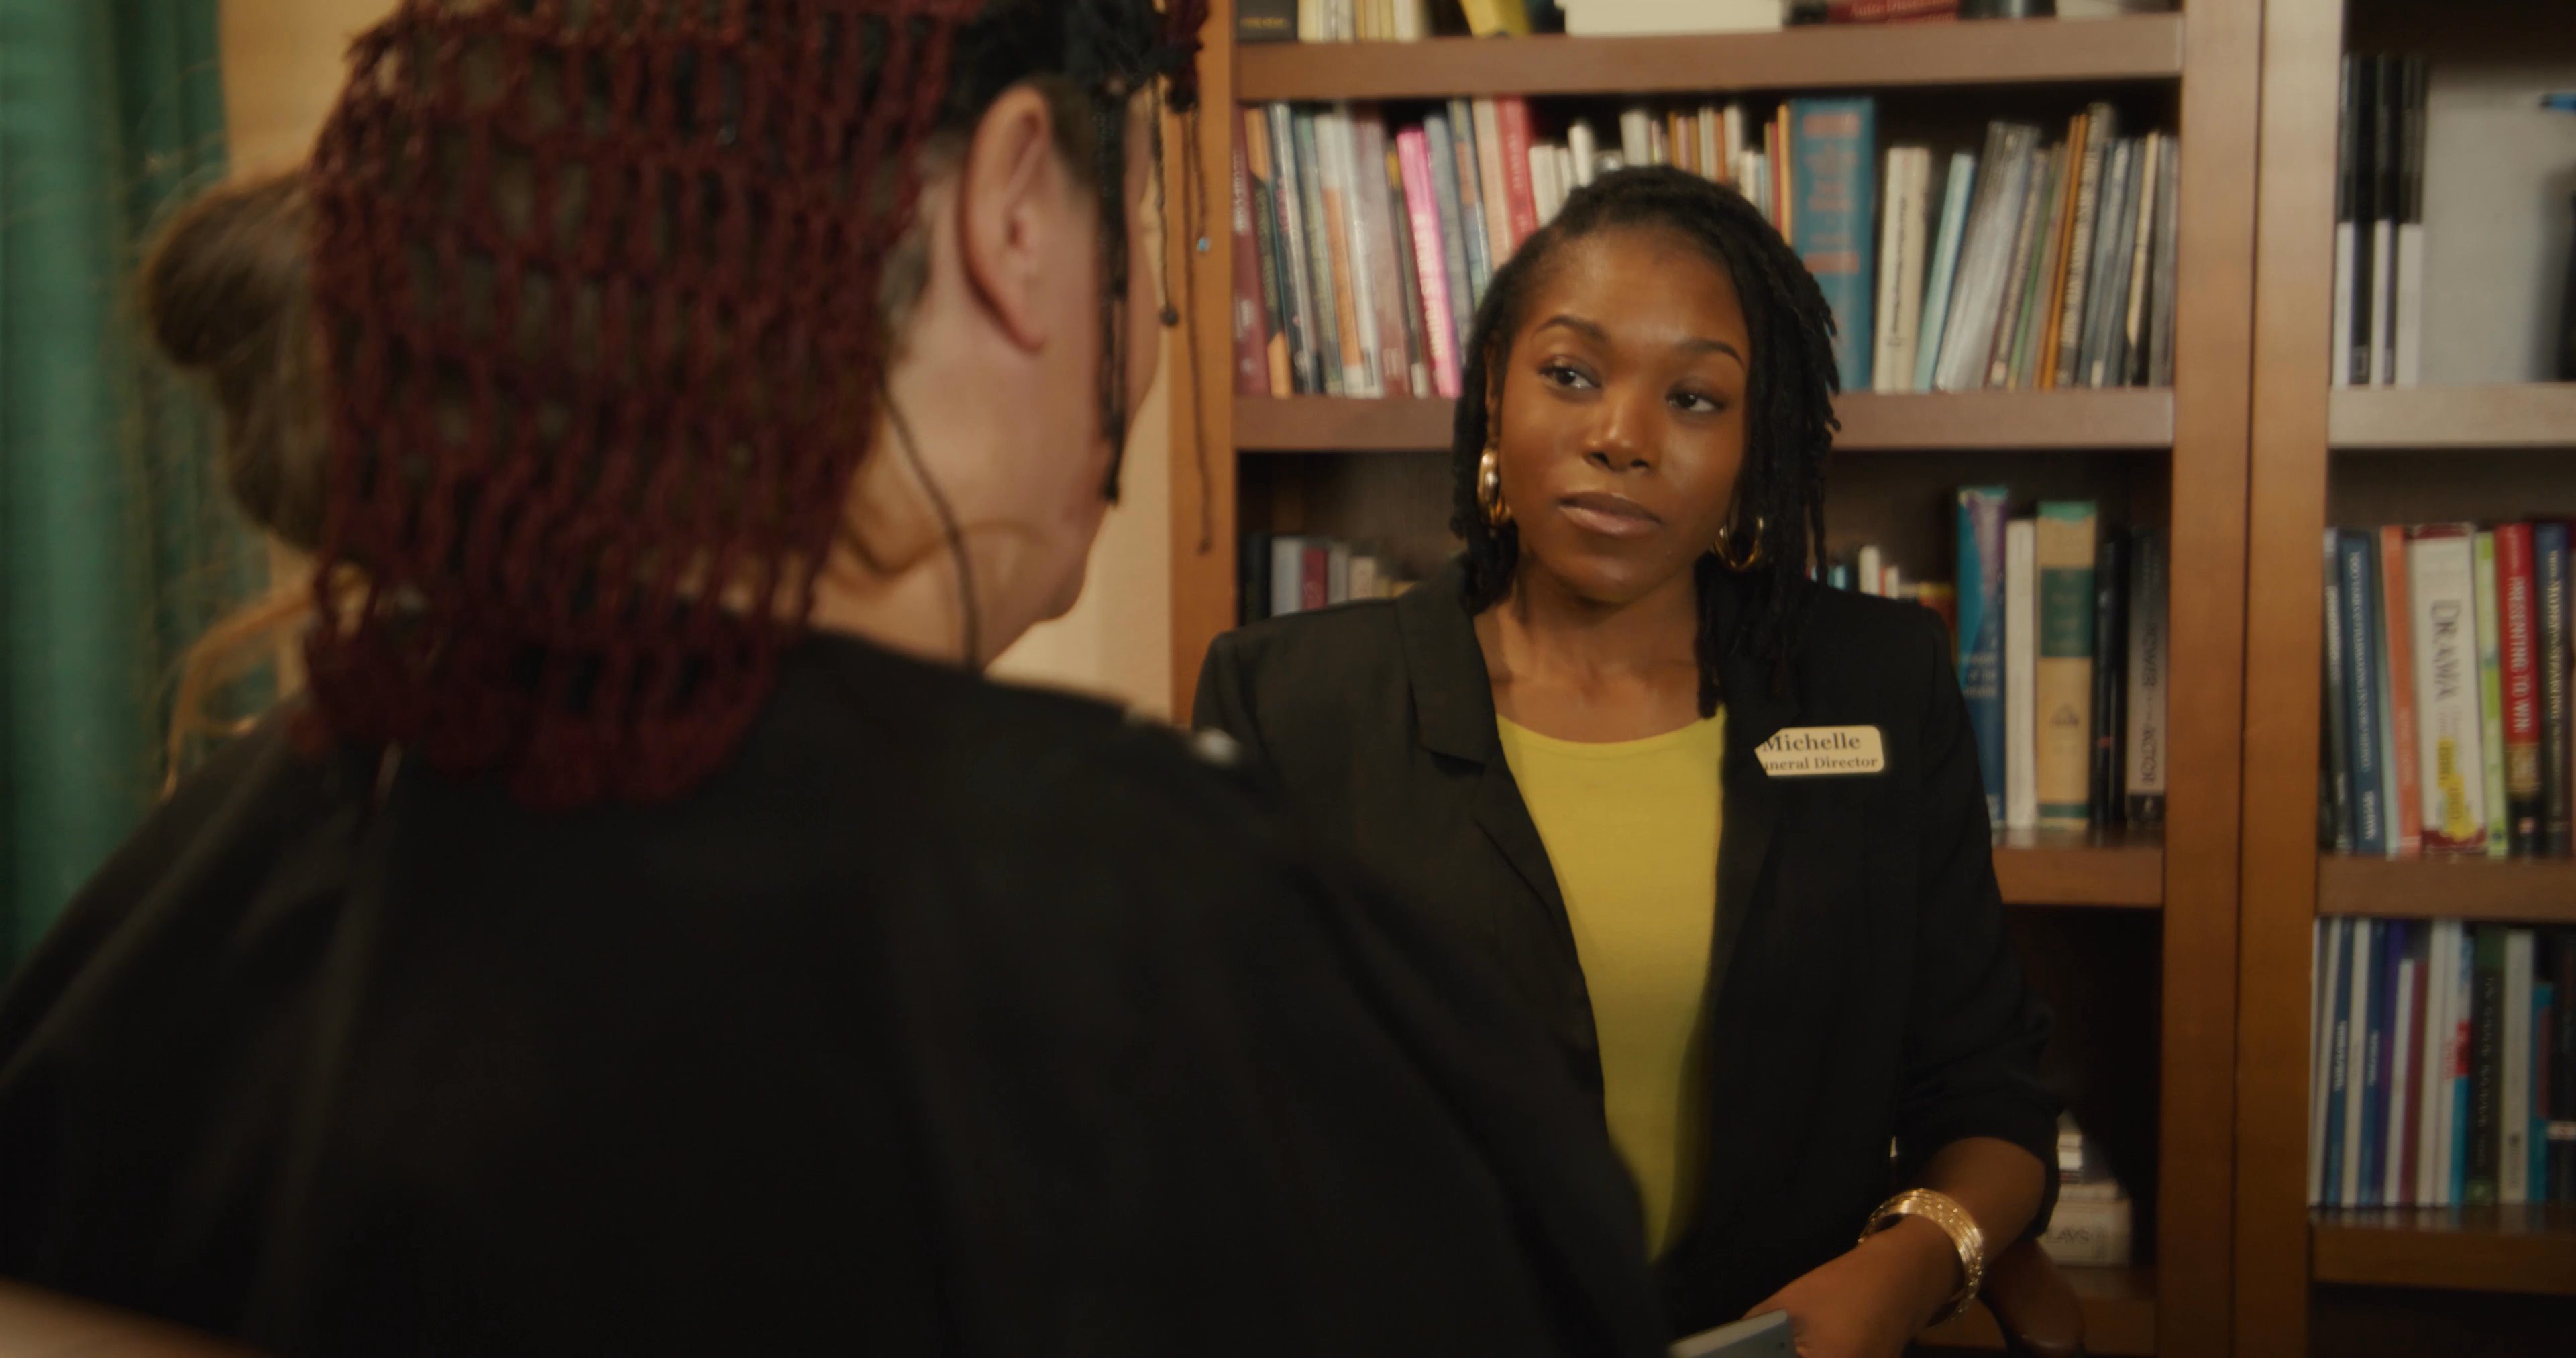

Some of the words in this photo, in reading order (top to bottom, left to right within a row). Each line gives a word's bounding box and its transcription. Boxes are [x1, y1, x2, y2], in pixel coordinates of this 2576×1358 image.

[2508, 577, 2528, 672] PRESENTING
[2142, 622, 2159, 688] POWER
[2430, 600, 2461, 702] DRAMA
[2512, 673, 2530, 698] TO
[2512, 698, 2531, 733] WIN
[1762, 732, 1861, 752] Michelle
[1815, 755, 1878, 770] Director
[2141, 723, 2157, 785] ACTOR
